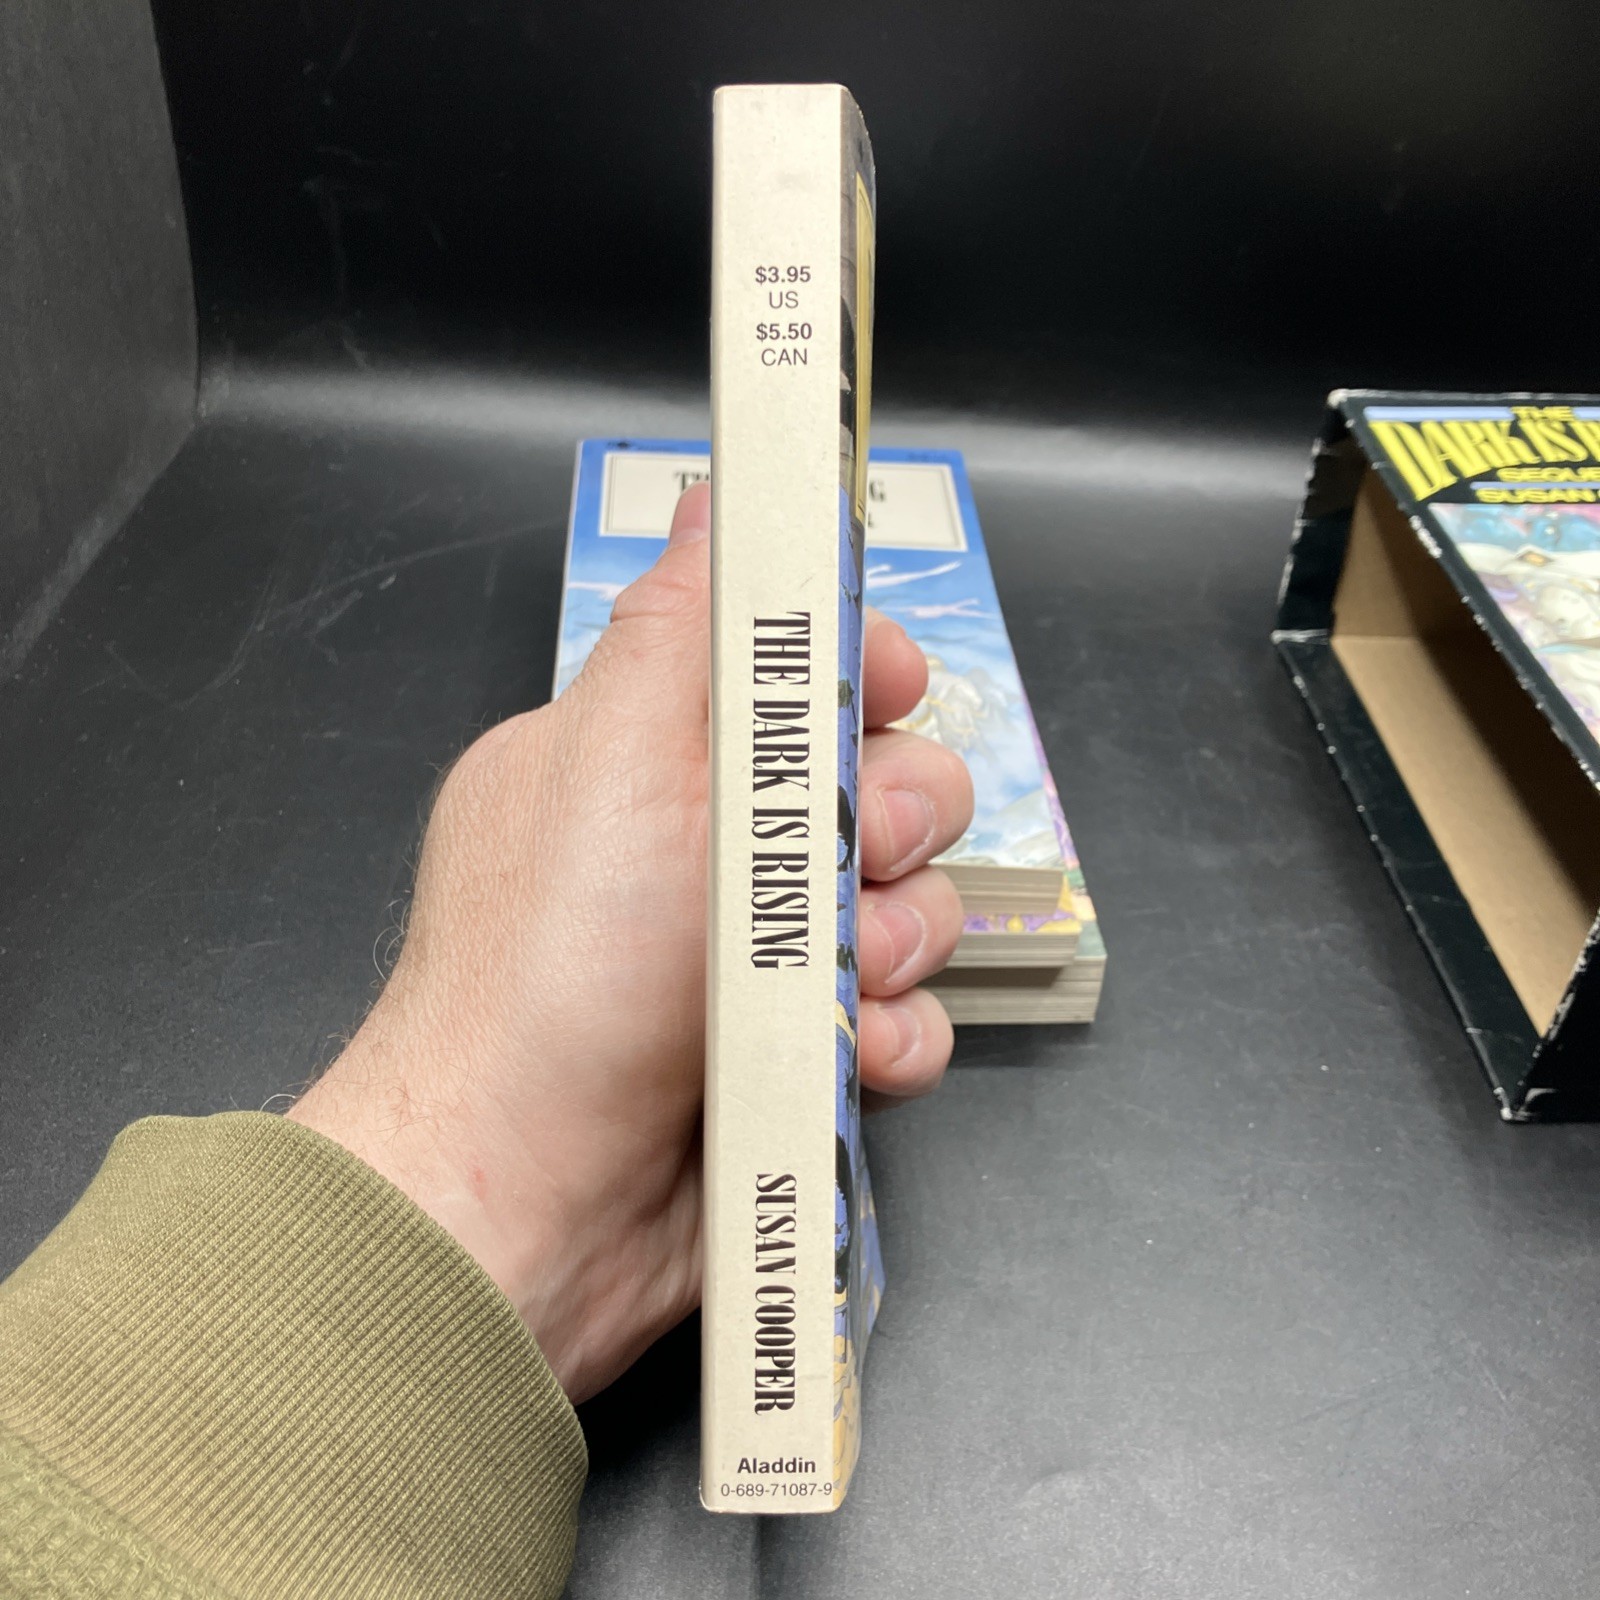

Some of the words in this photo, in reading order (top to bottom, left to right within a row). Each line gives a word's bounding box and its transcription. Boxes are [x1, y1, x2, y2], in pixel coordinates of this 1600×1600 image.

[755, 265, 812, 286] $3.95
[768, 291, 799, 309] US
[756, 322, 813, 342] $5.50
[761, 348, 808, 366] CAN
[1510, 406, 1574, 421] THE
[1368, 420, 1541, 501] DARK
[1518, 420, 1588, 462] IS
[1475, 488, 1597, 503] SUSAN
[753, 611, 811, 685] THE
[752, 698, 810, 793] DARK
[751, 806, 810, 840] IS
[750, 851, 810, 970] RISING
[755, 1173, 797, 1274] SUSAN
[754, 1285, 797, 1416] COOPER
[737, 1457, 816, 1474] Aladdin
[720, 1482, 833, 1497] 0-689-71087-9
